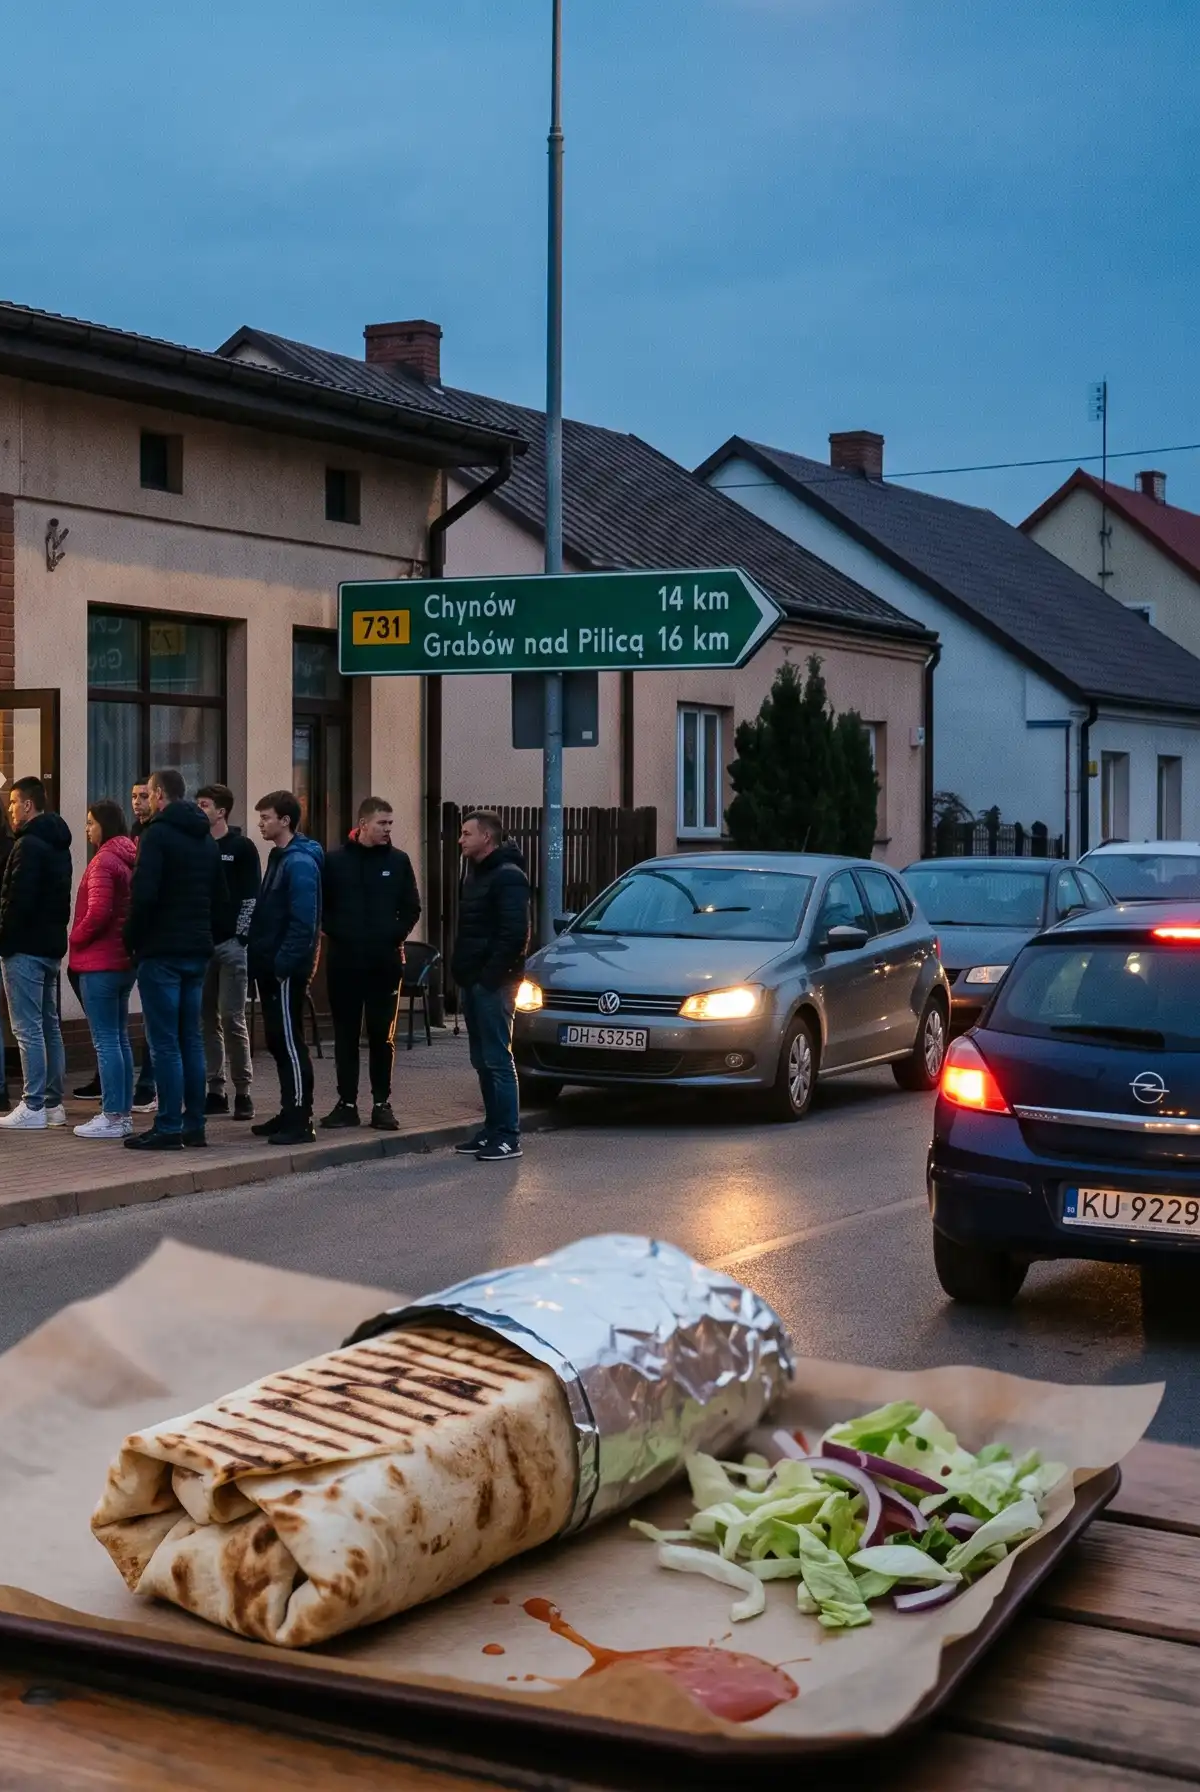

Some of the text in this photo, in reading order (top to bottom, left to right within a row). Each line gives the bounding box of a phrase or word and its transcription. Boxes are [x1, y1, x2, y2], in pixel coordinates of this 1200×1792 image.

[424, 584, 729, 626] Chynów 14 km
[362, 615, 400, 639] 731
[423, 624, 729, 659] Grabów nad Pilicą 16 km
[1082, 1191, 1121, 1219] KU
[1131, 1195, 1200, 1226] 9229
